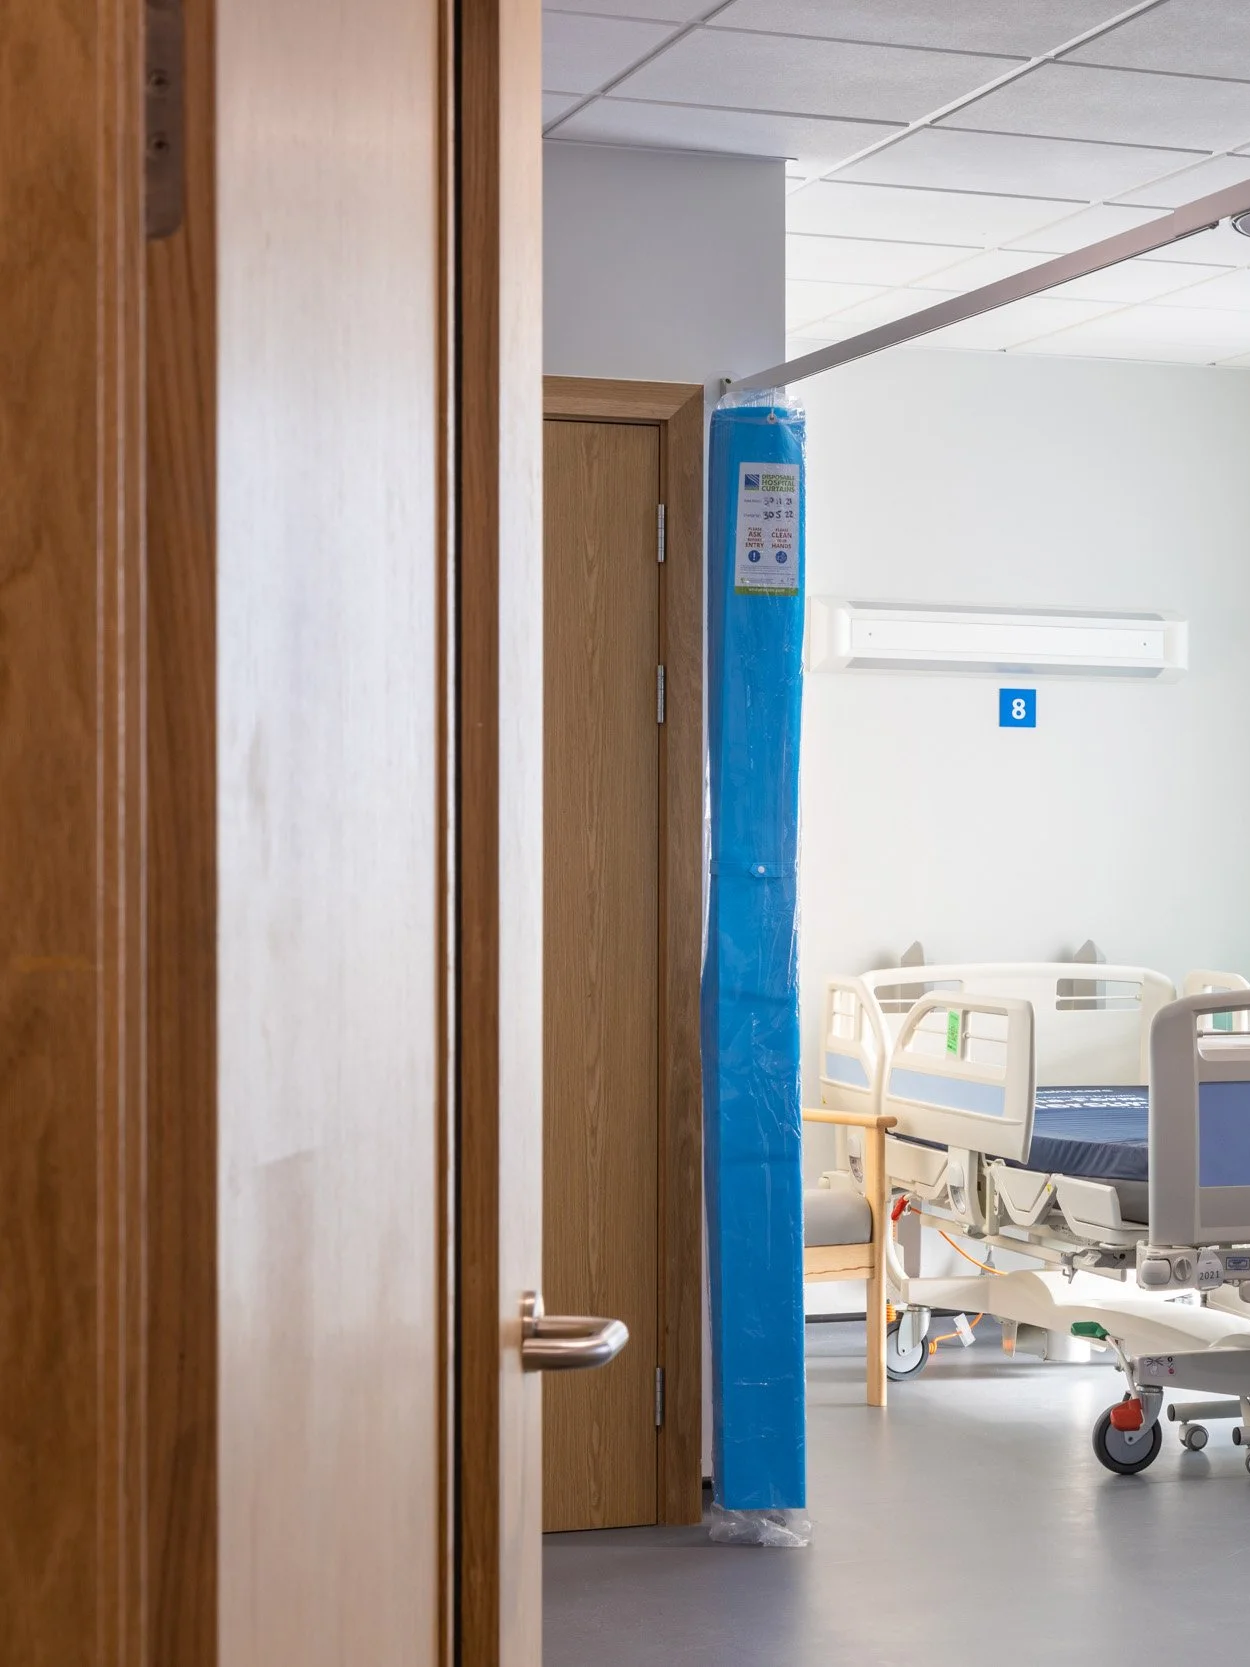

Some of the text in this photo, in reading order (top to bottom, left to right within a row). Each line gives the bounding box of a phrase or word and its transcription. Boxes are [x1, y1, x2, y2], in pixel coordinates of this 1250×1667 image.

[761, 479, 795, 487] HOSPITAL
[763, 511, 774, 520] 30
[784, 510, 794, 518] 22
[1012, 698, 1026, 720] 8
[1200, 1270, 1219, 1280] 2021
